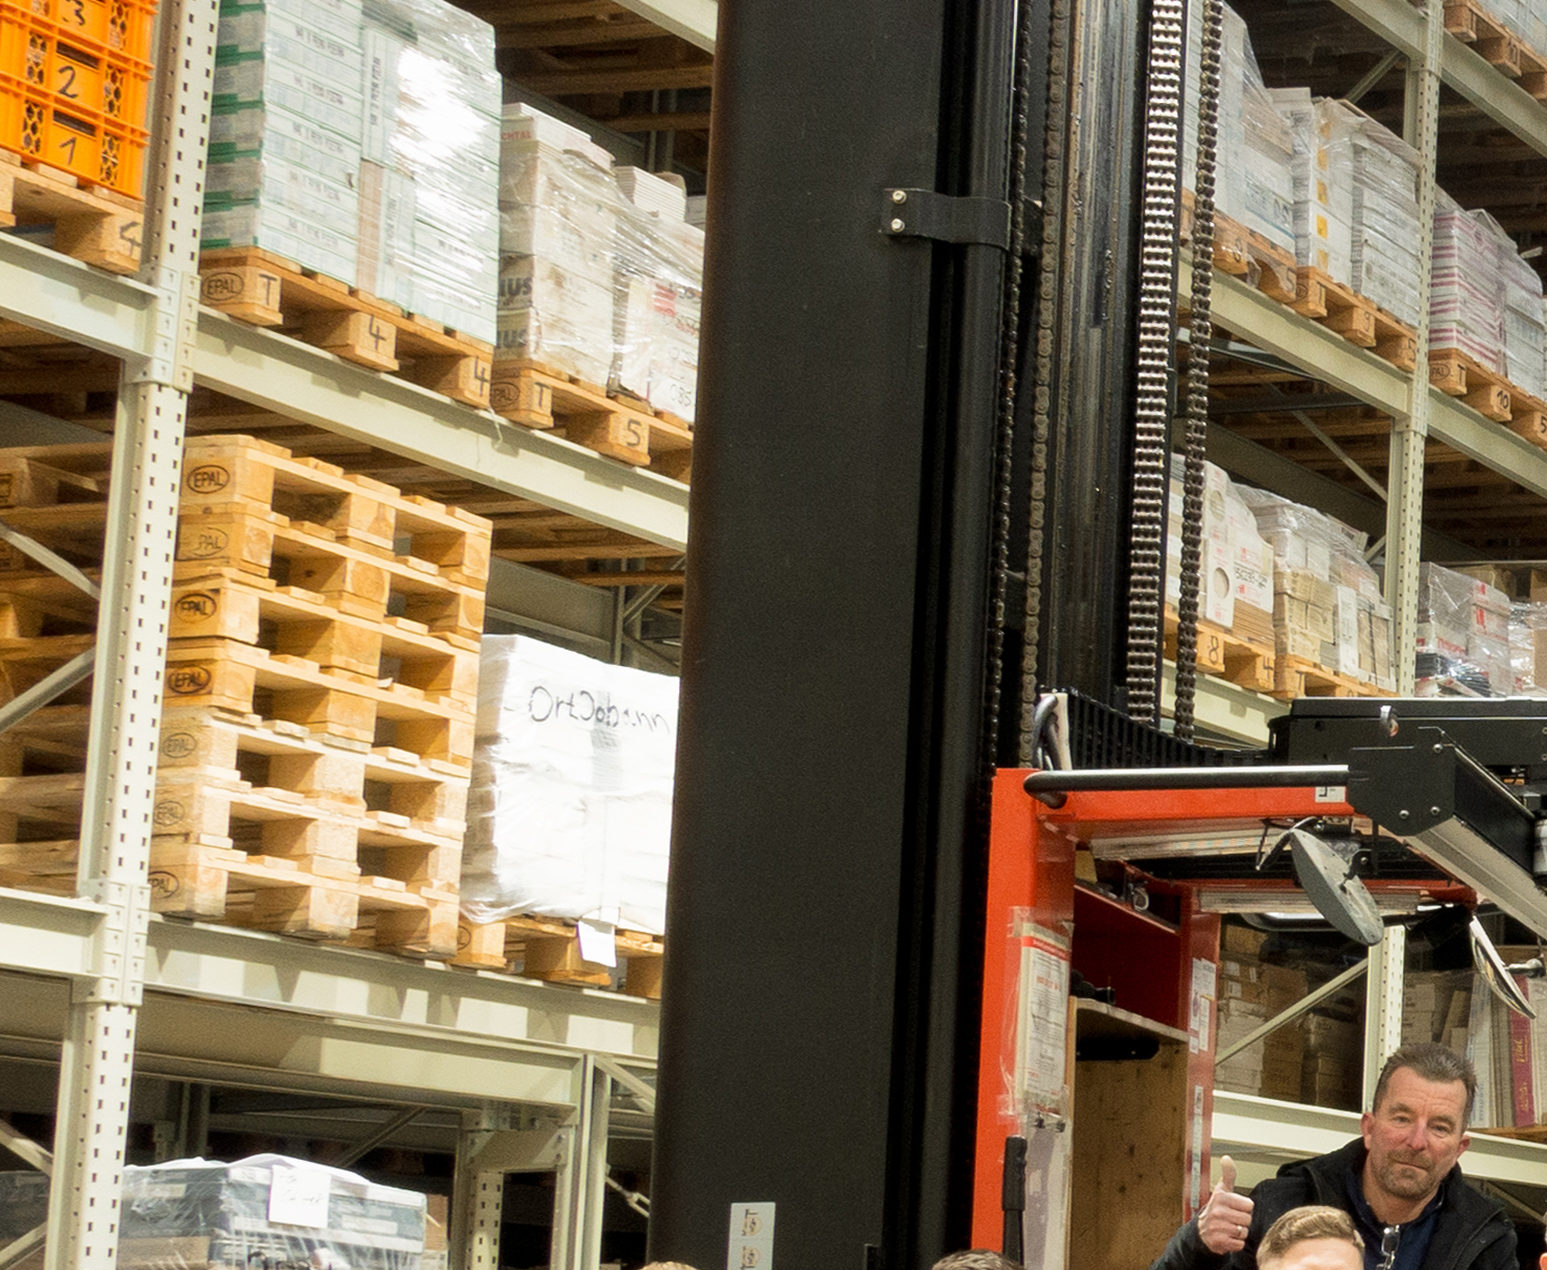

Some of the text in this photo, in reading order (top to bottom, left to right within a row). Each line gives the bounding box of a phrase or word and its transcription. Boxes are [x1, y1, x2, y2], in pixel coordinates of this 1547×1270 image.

[58, 65, 79, 99] 2
[59, 136, 77, 166] 1
[206, 277, 237, 296] EPAL
[259, 273, 278, 306] T
[368, 314, 386, 352] 4
[1457, 363, 1466, 384] T
[533, 382, 551, 408] T
[1497, 389, 1509, 410] 10
[627, 419, 642, 447] 5
[1540, 416, 1547, 434] 5
[193, 473, 224, 488] EPAL
